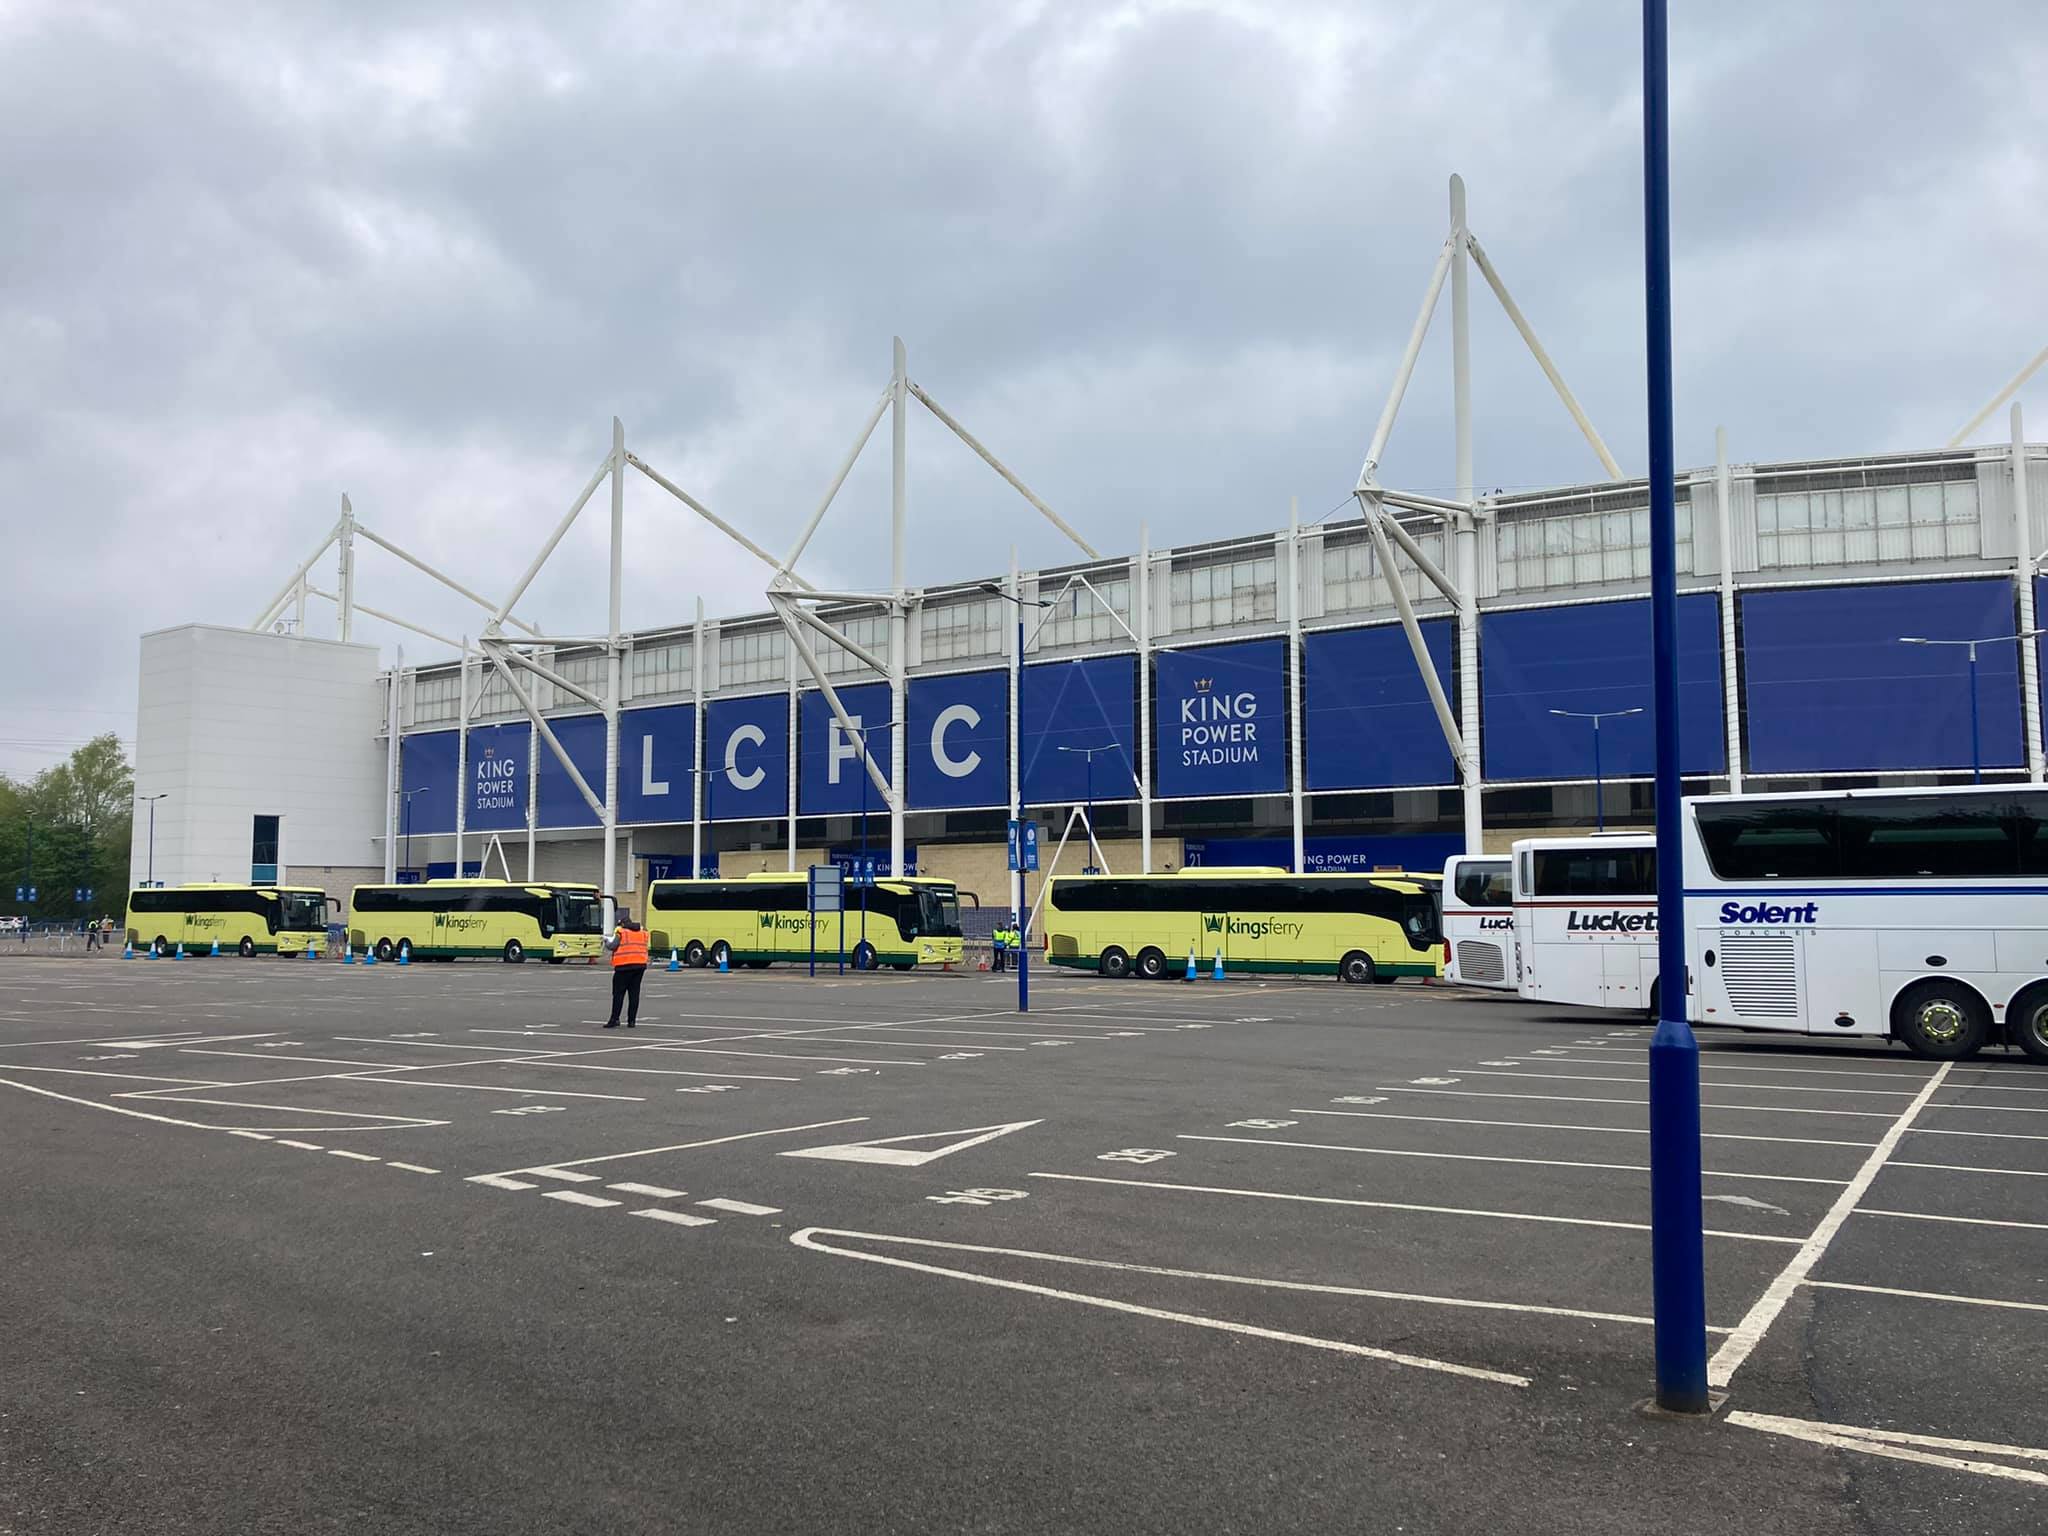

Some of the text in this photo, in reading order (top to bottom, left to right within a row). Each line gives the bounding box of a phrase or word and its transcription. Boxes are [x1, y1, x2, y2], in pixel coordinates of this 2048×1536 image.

[1181, 692, 1257, 723] KING
[1182, 723, 1257, 746] POWER
[1182, 746, 1259, 767] STADIUM
[477, 759, 515, 779] KING
[477, 780, 514, 795] POWER
[477, 796, 515, 810] STADIUM
[1303, 854, 1366, 865] ING POWER
[655, 865, 669, 879] 17
[1719, 901, 1819, 924] Solent
[194, 914, 227, 930] kingsferry
[445, 917, 488, 932] kingsferry
[1227, 916, 1304, 939] kingsferry
[1479, 917, 1515, 931] Luck
[1567, 911, 1659, 932] Lucket
[1719, 929, 1817, 937] COACHES
